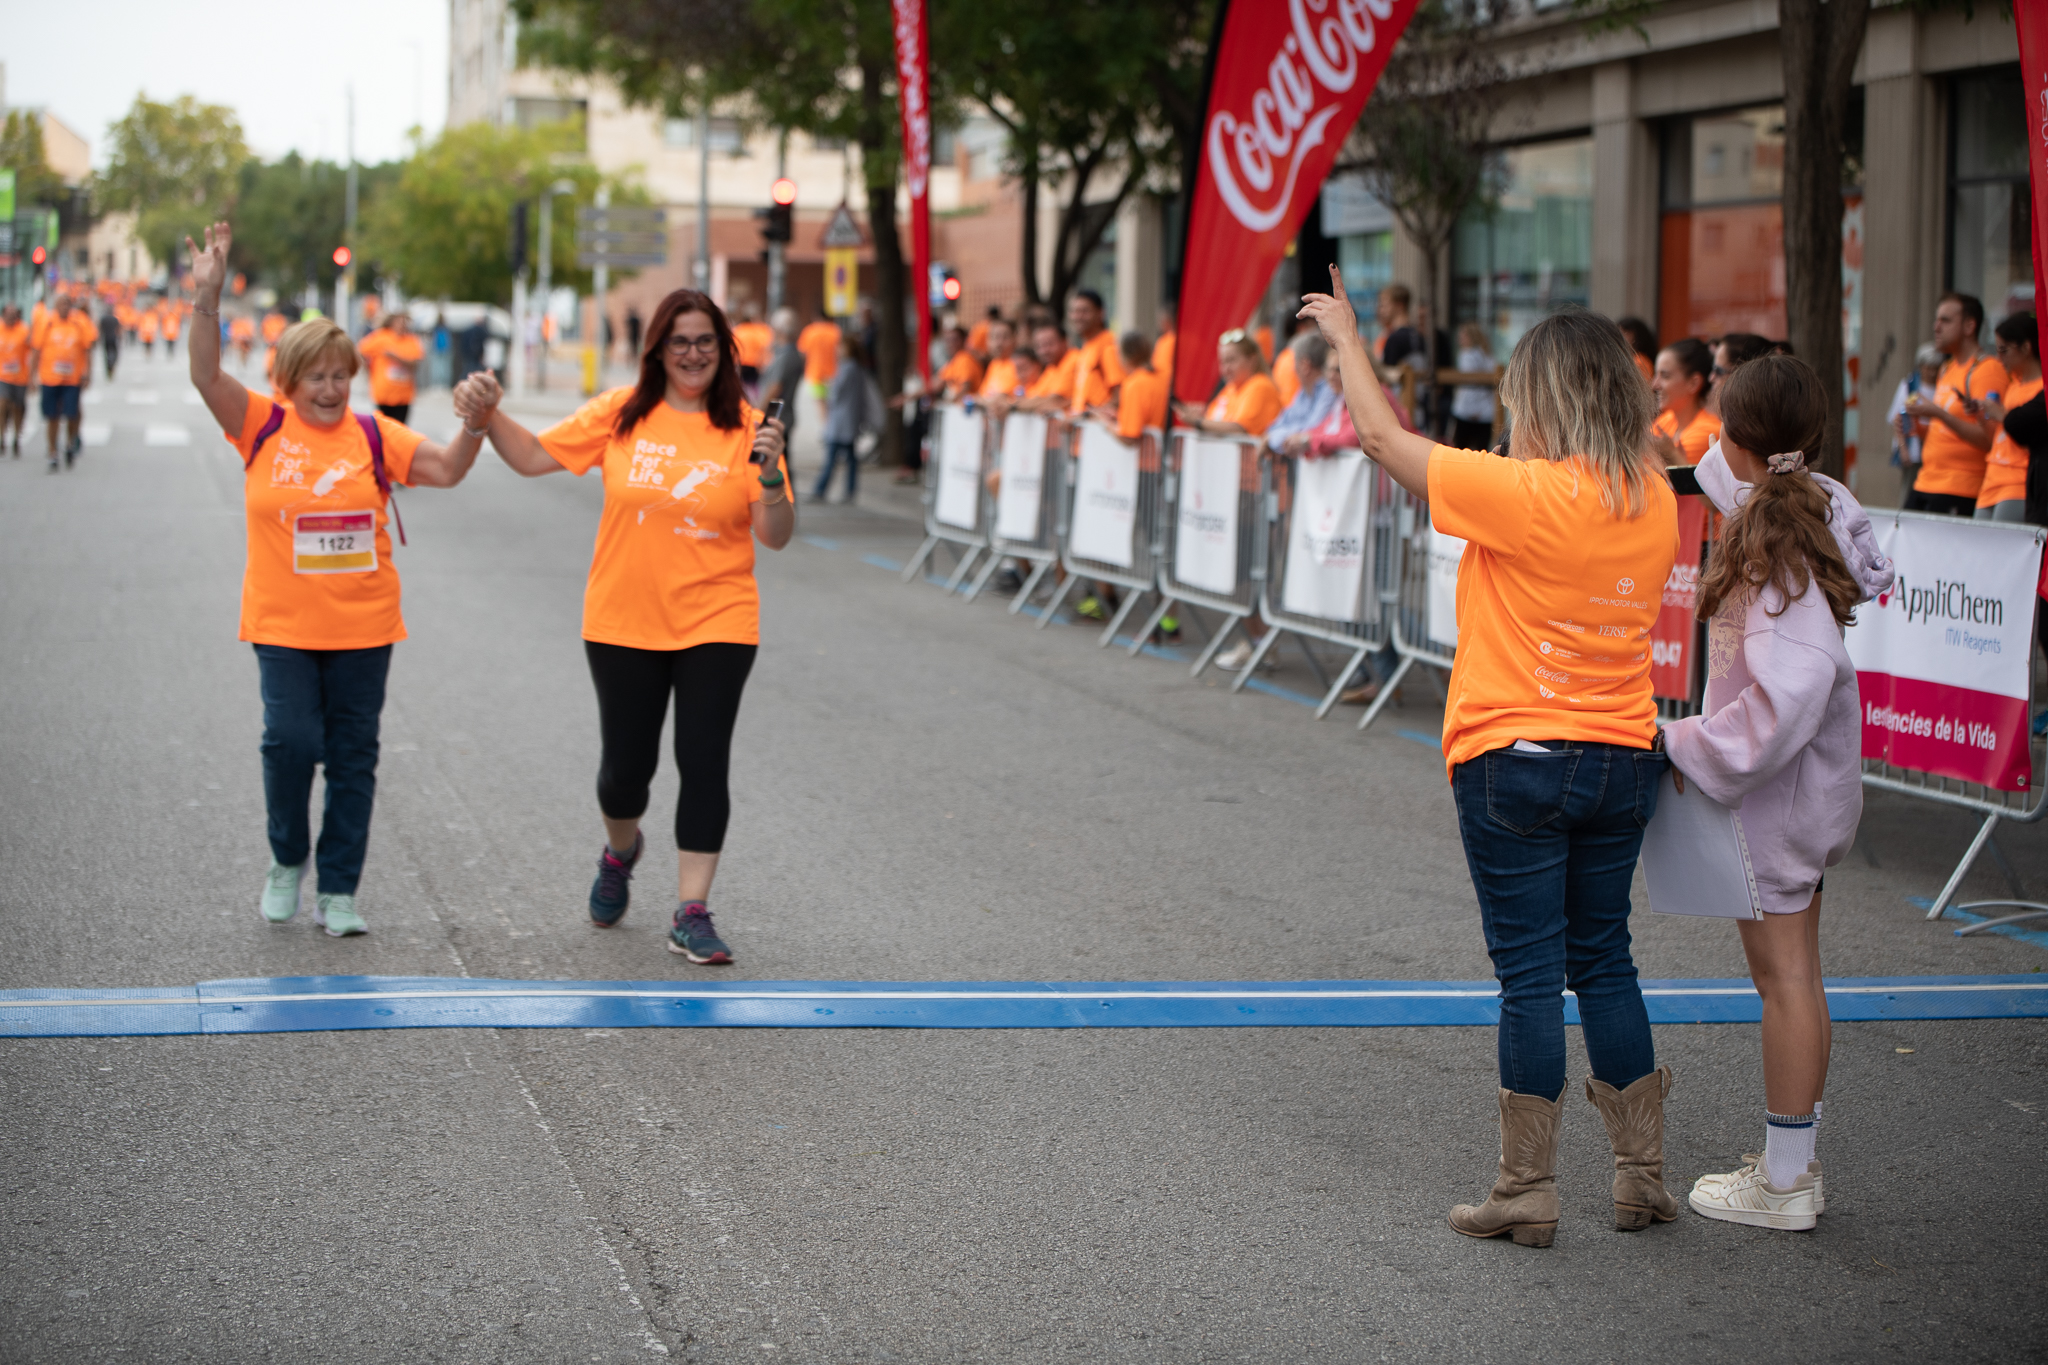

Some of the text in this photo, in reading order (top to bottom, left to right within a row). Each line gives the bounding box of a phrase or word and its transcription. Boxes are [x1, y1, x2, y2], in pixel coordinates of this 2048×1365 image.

[635, 439, 677, 457] Race
[632, 454, 662, 469] For
[272, 467, 304, 485] Life
[628, 467, 664, 485] Life
[319, 535, 354, 552] 1122
[1588, 597, 1608, 606] IPPON
[1609, 599, 1630, 608] MOTOR
[1893, 575, 2003, 627] AppliChem
[1598, 625, 1628, 638] YERSE
[1945, 628, 2002, 656] ITW Reagents
[1934, 713, 1952, 741] de
[1953, 716, 1966, 744] la
[1968, 720, 1996, 751] Vida
